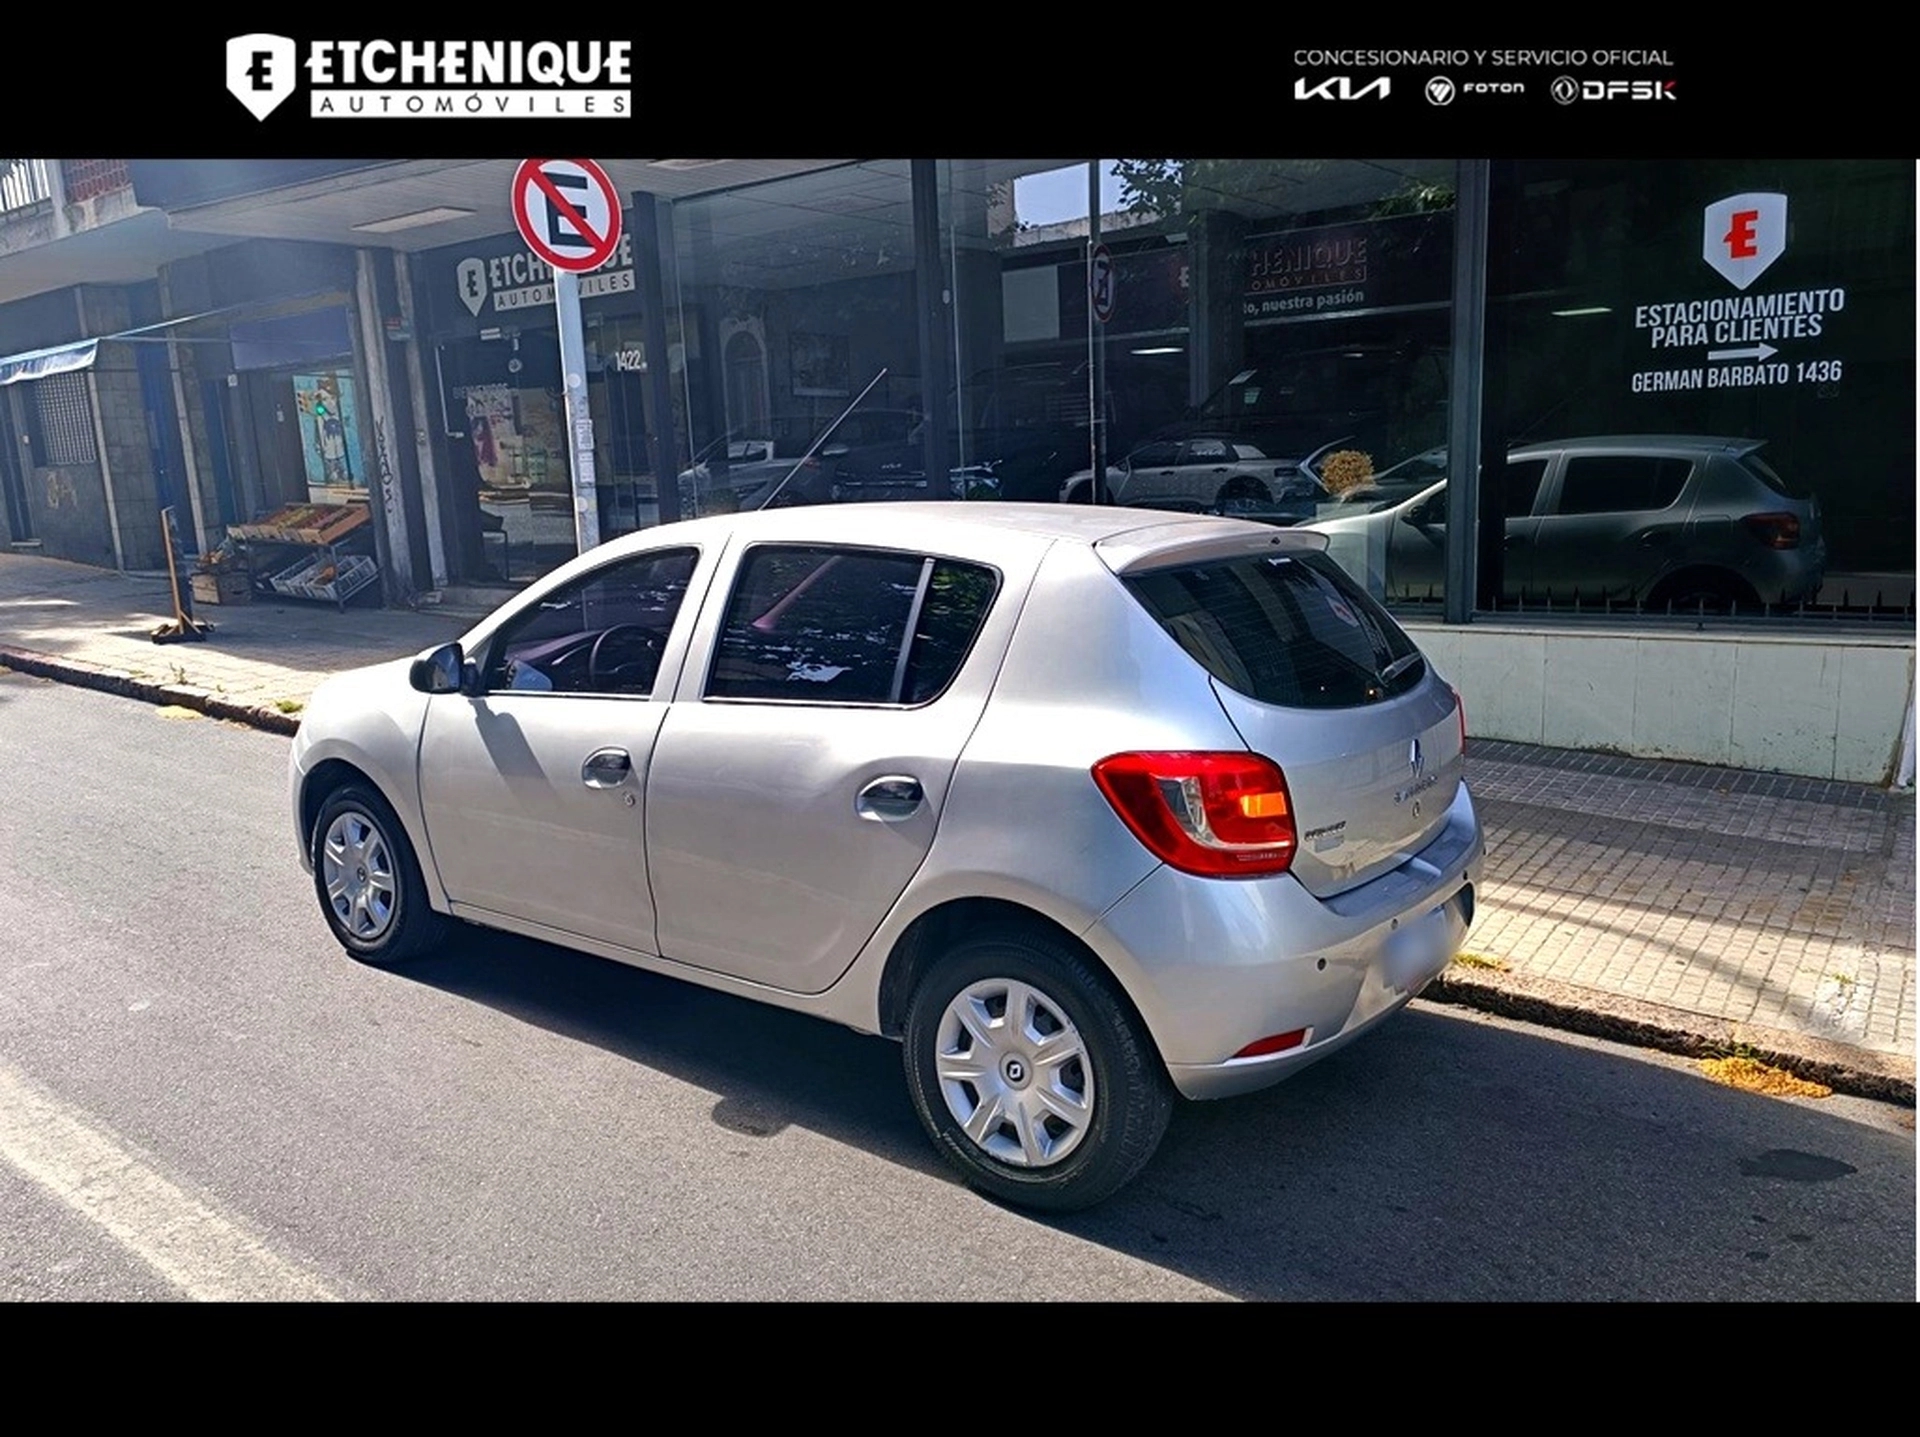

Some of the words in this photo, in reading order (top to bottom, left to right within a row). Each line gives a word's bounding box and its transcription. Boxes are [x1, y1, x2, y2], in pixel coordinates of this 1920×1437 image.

[1262, 297, 1313, 312] nuestra
[1317, 288, 1364, 309] pasión
[1635, 288, 1845, 328] ESTACIONAMIENTO
[1651, 323, 1709, 349] PARA
[1715, 313, 1823, 343] CLIENTES
[615, 350, 641, 372] 1422
[1632, 368, 1703, 393] GERMAN
[1707, 363, 1789, 389] BARBATO
[1797, 360, 1842, 383] 1436
